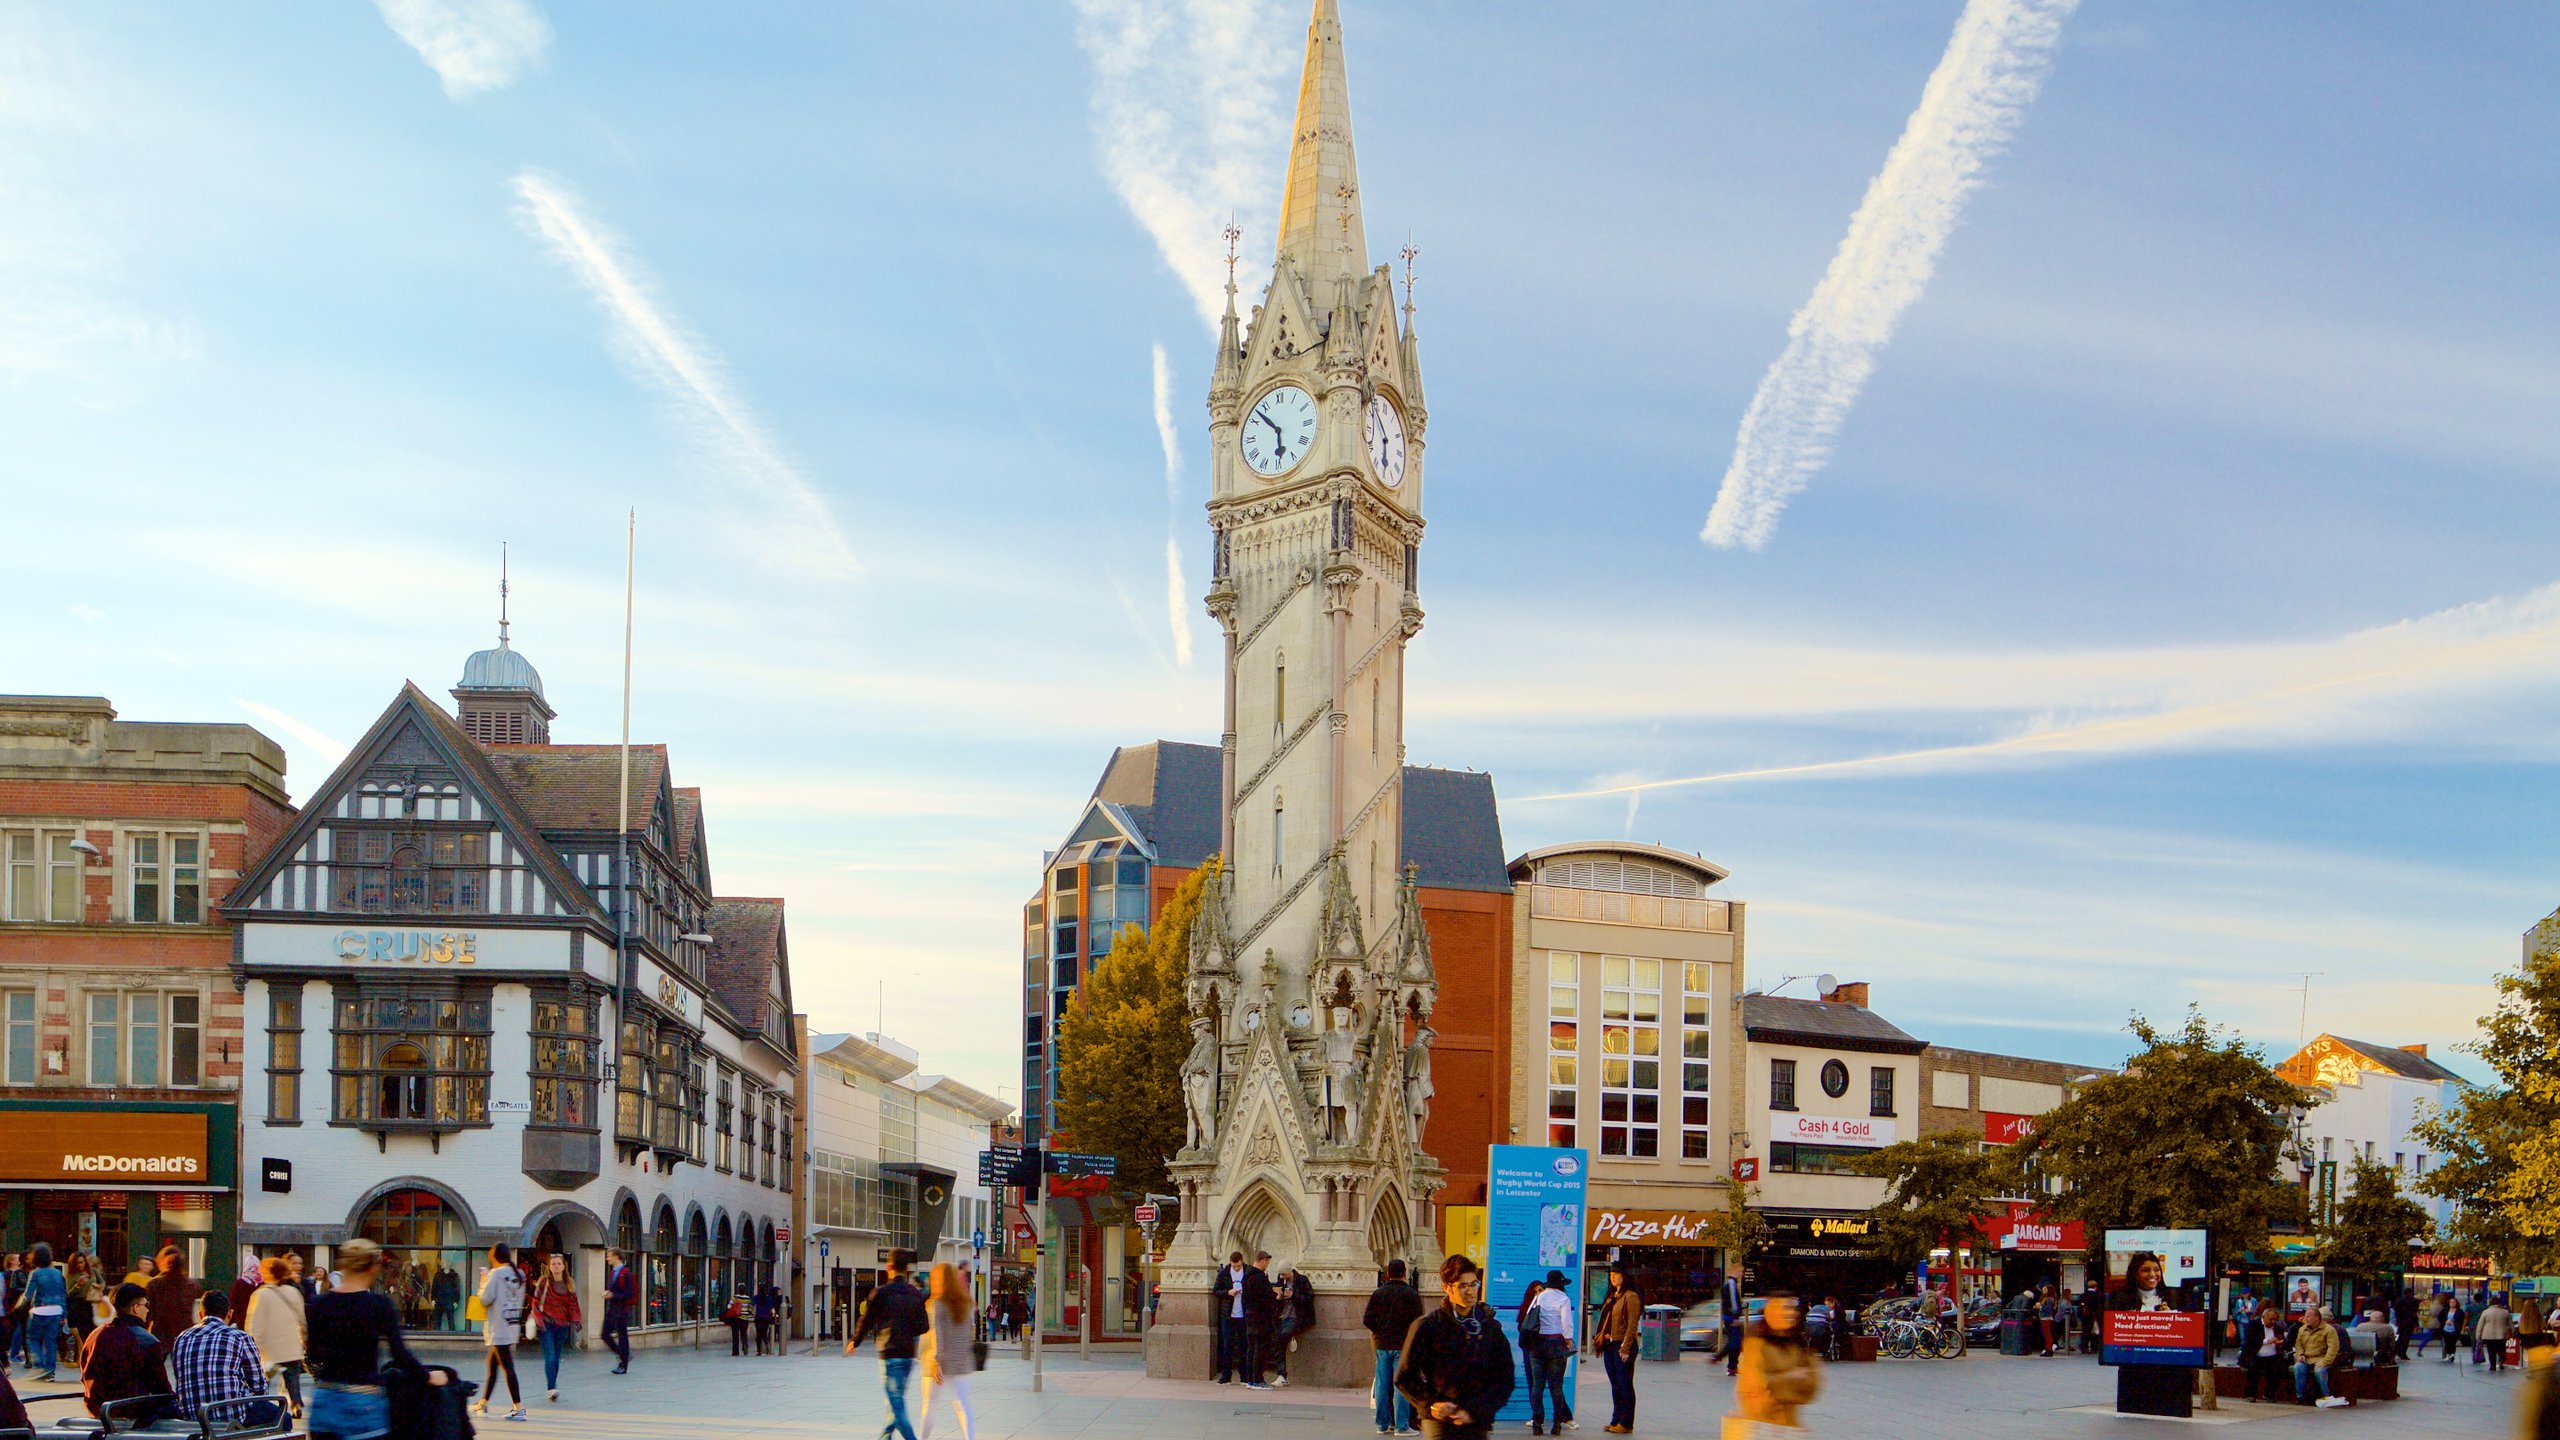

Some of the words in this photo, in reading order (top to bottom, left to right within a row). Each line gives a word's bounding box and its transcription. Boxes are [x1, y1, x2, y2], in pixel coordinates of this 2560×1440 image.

[1261, 400, 1271, 413] XI
[1250, 418, 1260, 426] X
[1246, 435, 1256, 444] IX
[333, 930, 477, 963] CRUISE
[1798, 1118, 1829, 1133] Cash
[1832, 1121, 1839, 1133] 4
[1842, 1121, 1870, 1135] Gold
[1799, 1131, 1813, 1139] Prices
[62, 1155, 197, 1173] McDonald's
[269, 1171, 289, 1181] CRUISE
[1497, 1169, 1533, 1177] Welcome
[1496, 1179, 1522, 1188] Rugby
[1548, 1181, 1562, 1189] Cup
[1563, 1181, 1581, 1189] 2015
[2324, 1165, 2333, 1196] Paddy
[1496, 1188, 1504, 1196] in
[1505, 1188, 1541, 1197] Leicester
[1592, 1212, 1660, 1242] Pizza
[1662, 1214, 1709, 1241] Hut
[1824, 1218, 1869, 1234] Mallard
[2013, 1223, 2062, 1242] BARGAINS
[1790, 1247, 1819, 1257] DIAMOND
[1819, 1249, 1825, 1257] &
[1825, 1249, 1848, 1257] WATCH
[2114, 1313, 2135, 1321] We've
[2136, 1314, 2150, 1322] just
[2134, 1322, 2172, 1330] directions?
